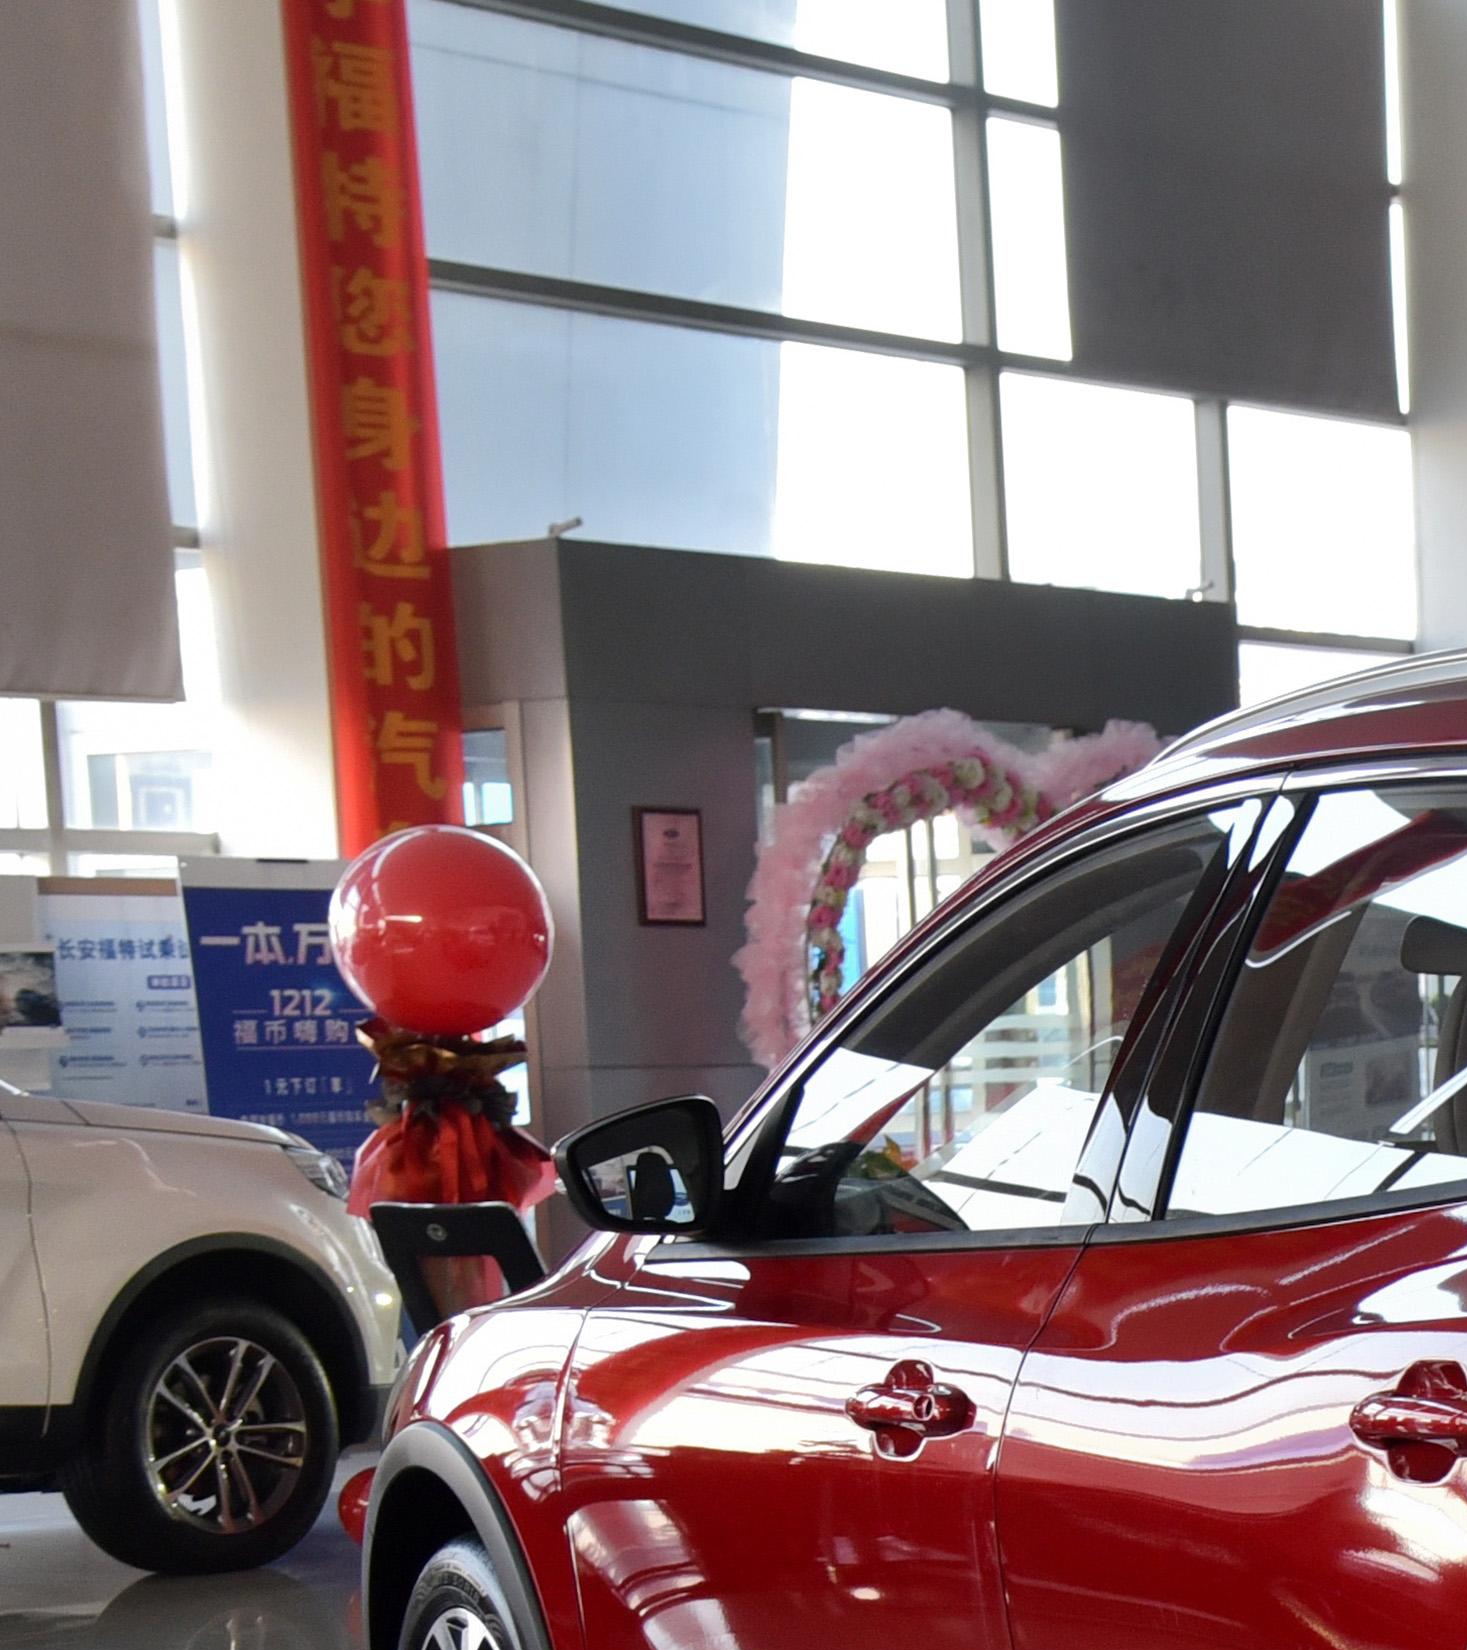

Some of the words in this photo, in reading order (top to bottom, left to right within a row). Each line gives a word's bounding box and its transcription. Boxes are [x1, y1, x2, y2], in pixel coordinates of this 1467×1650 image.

[311, 0, 449, 836] 福特您身边的汽
[268, 988, 332, 1017] 1212
[232, 1017, 366, 1046] 福币嗨购
